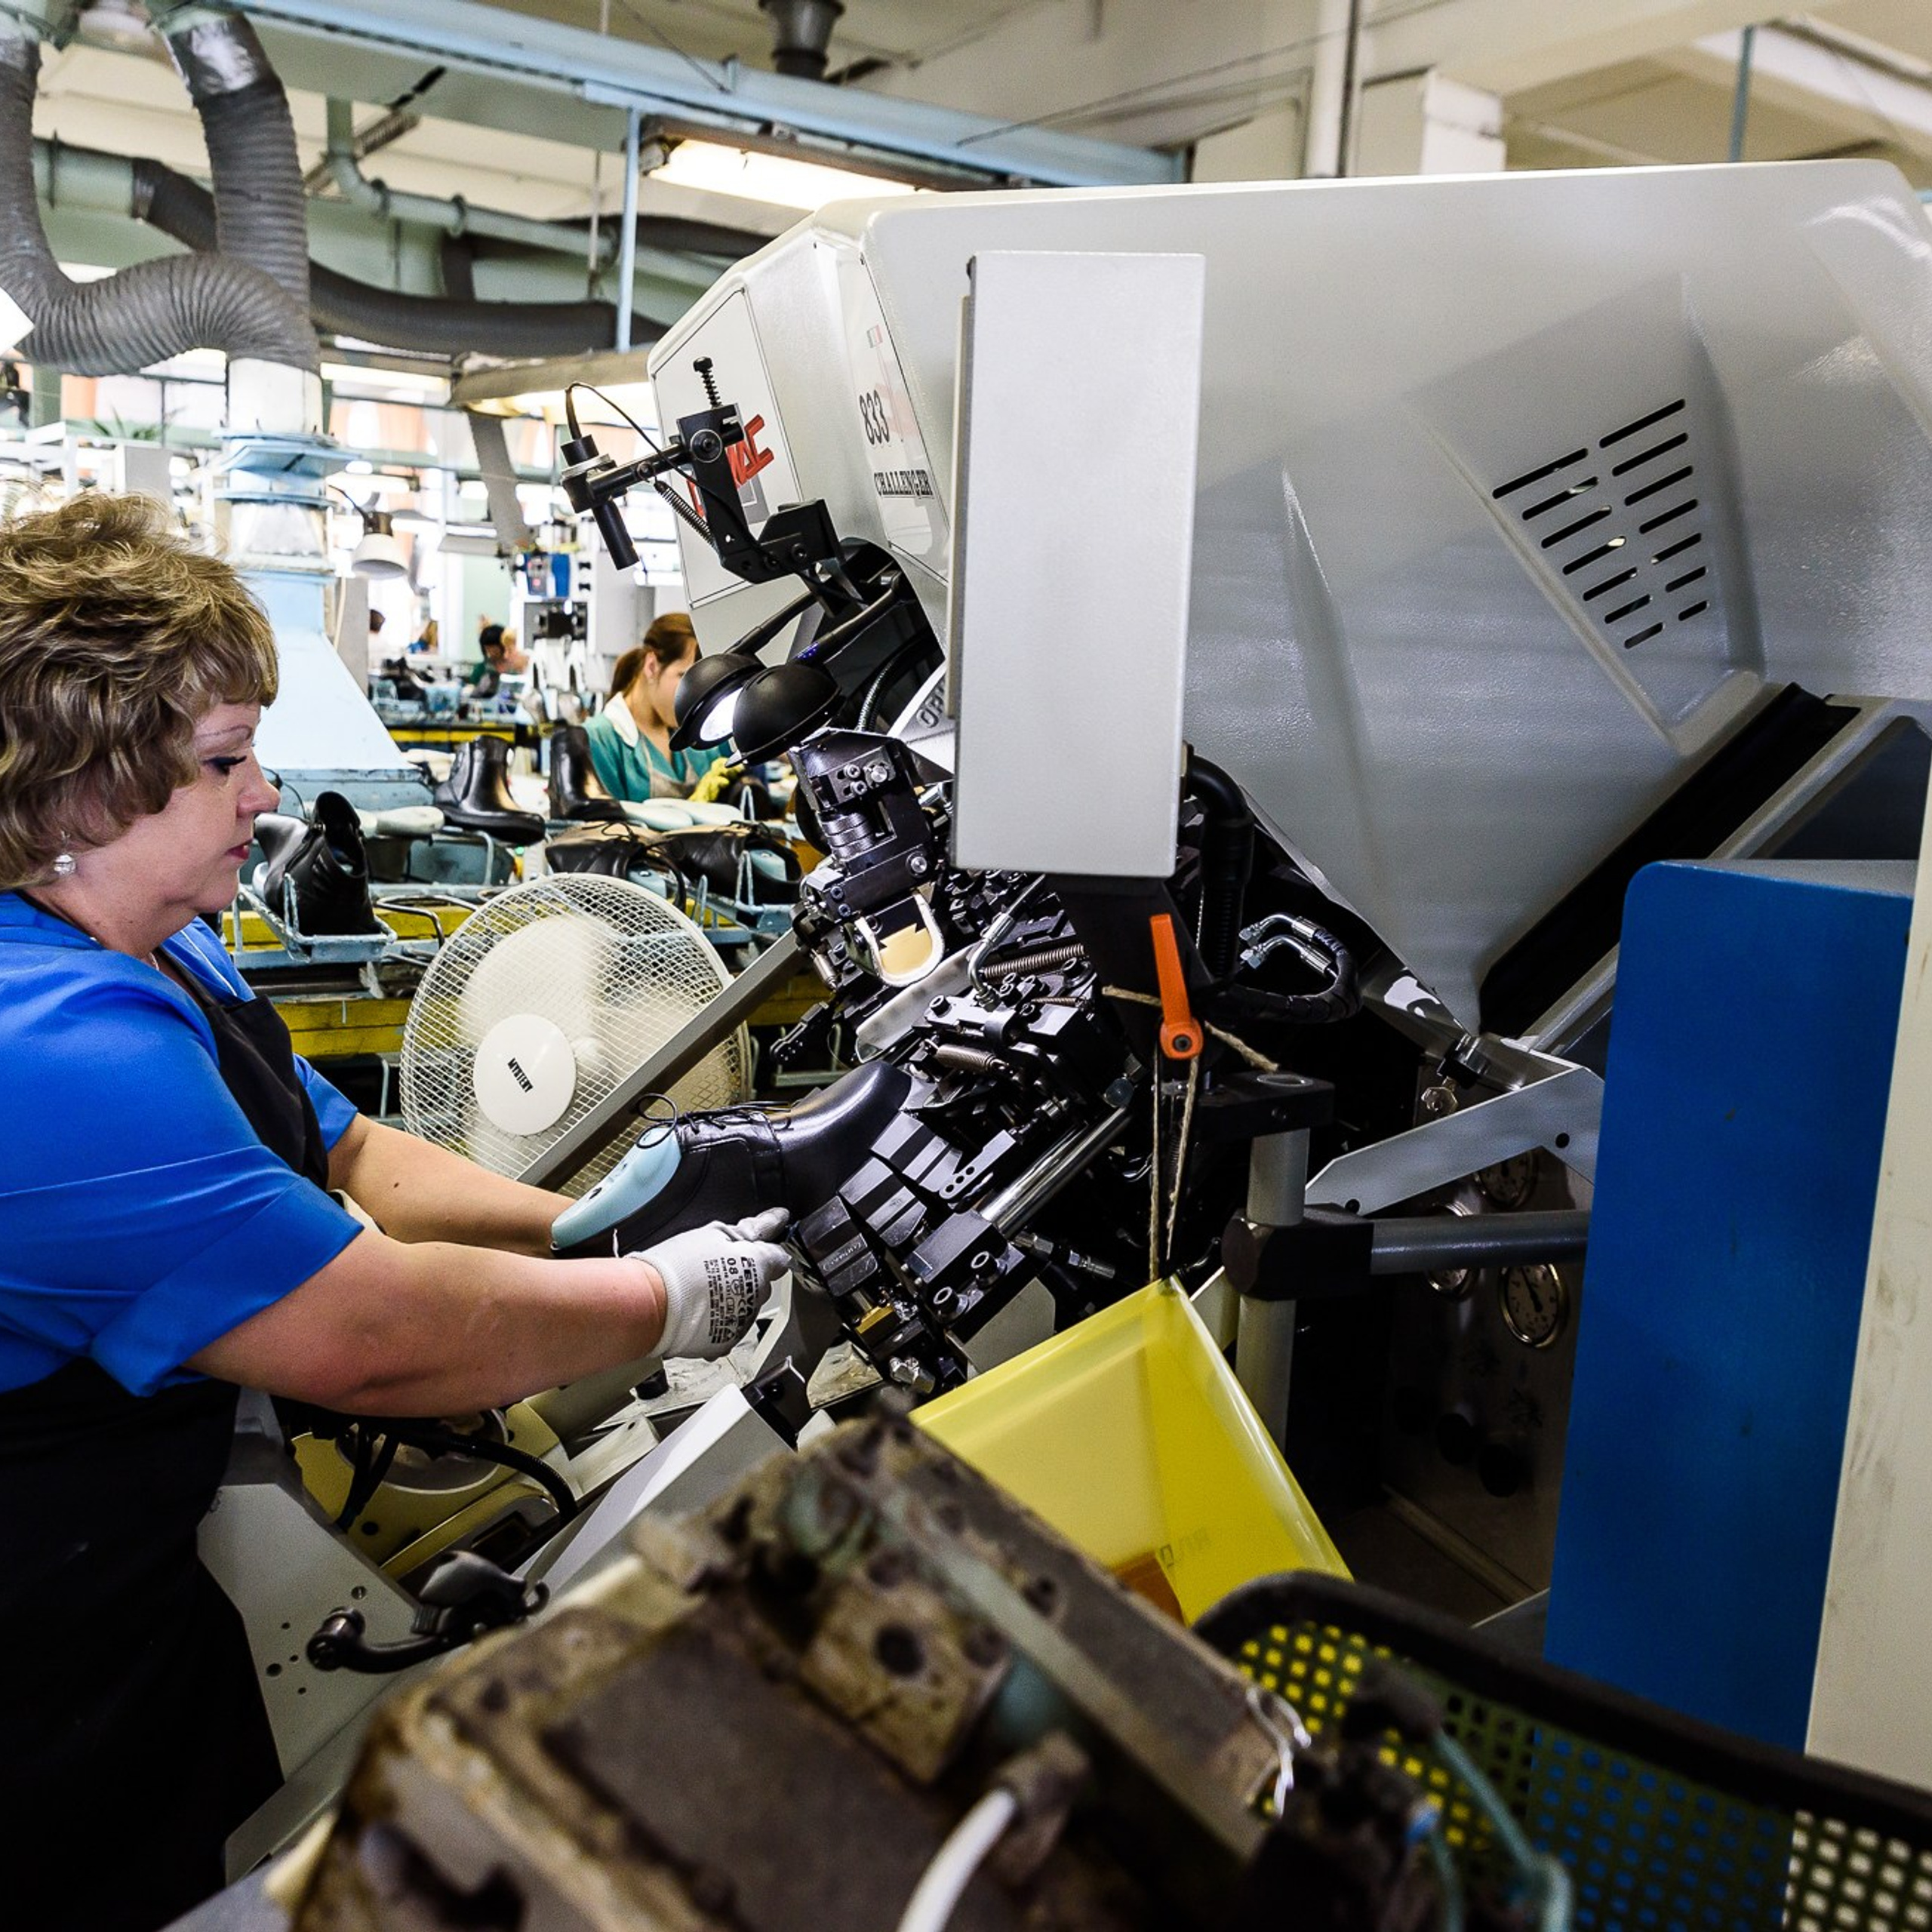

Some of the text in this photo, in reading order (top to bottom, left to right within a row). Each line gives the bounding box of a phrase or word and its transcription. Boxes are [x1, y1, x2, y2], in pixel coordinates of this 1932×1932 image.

[859, 389, 890, 445] 833
[874, 469, 934, 497] CHALLENGER
[507, 1057, 534, 1093] MYSTERY
[727, 1257, 739, 1275] 08
[740, 1256, 755, 1317] CERVA
